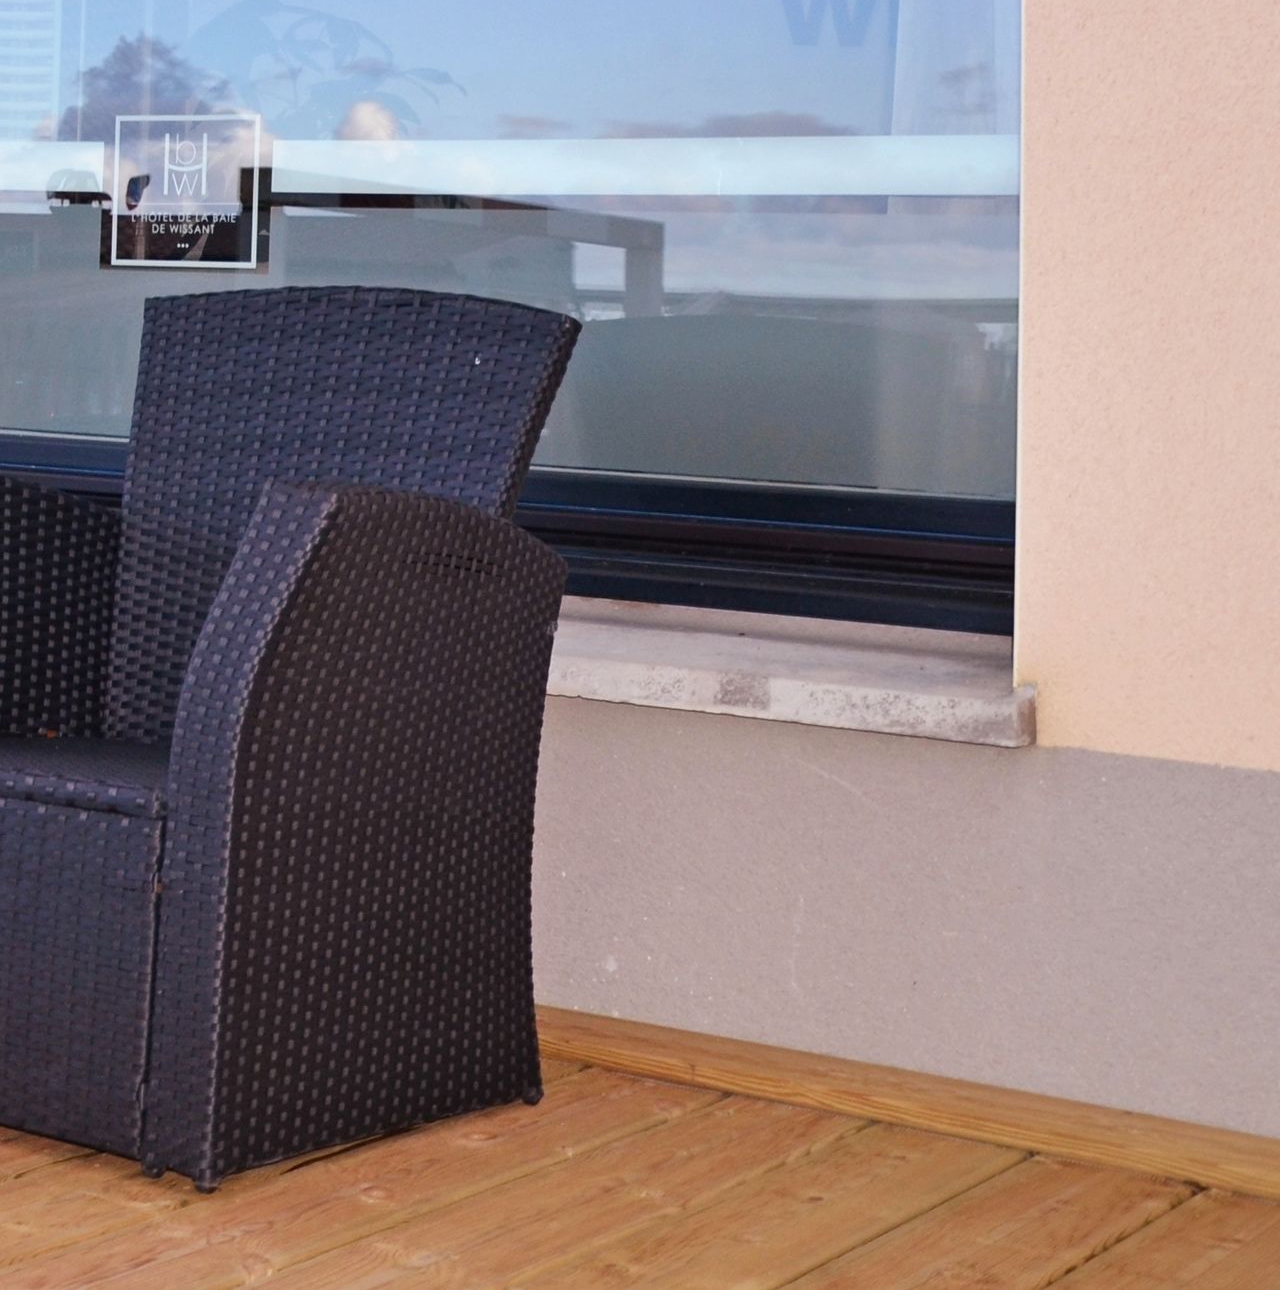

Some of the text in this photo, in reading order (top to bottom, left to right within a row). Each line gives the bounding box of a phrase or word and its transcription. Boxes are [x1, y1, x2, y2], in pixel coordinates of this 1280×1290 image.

[178, 213, 193, 223] DE
[196, 213, 209, 223] LA
[212, 213, 237, 223] BAIE
[152, 223, 216, 235] DE WISSANT
